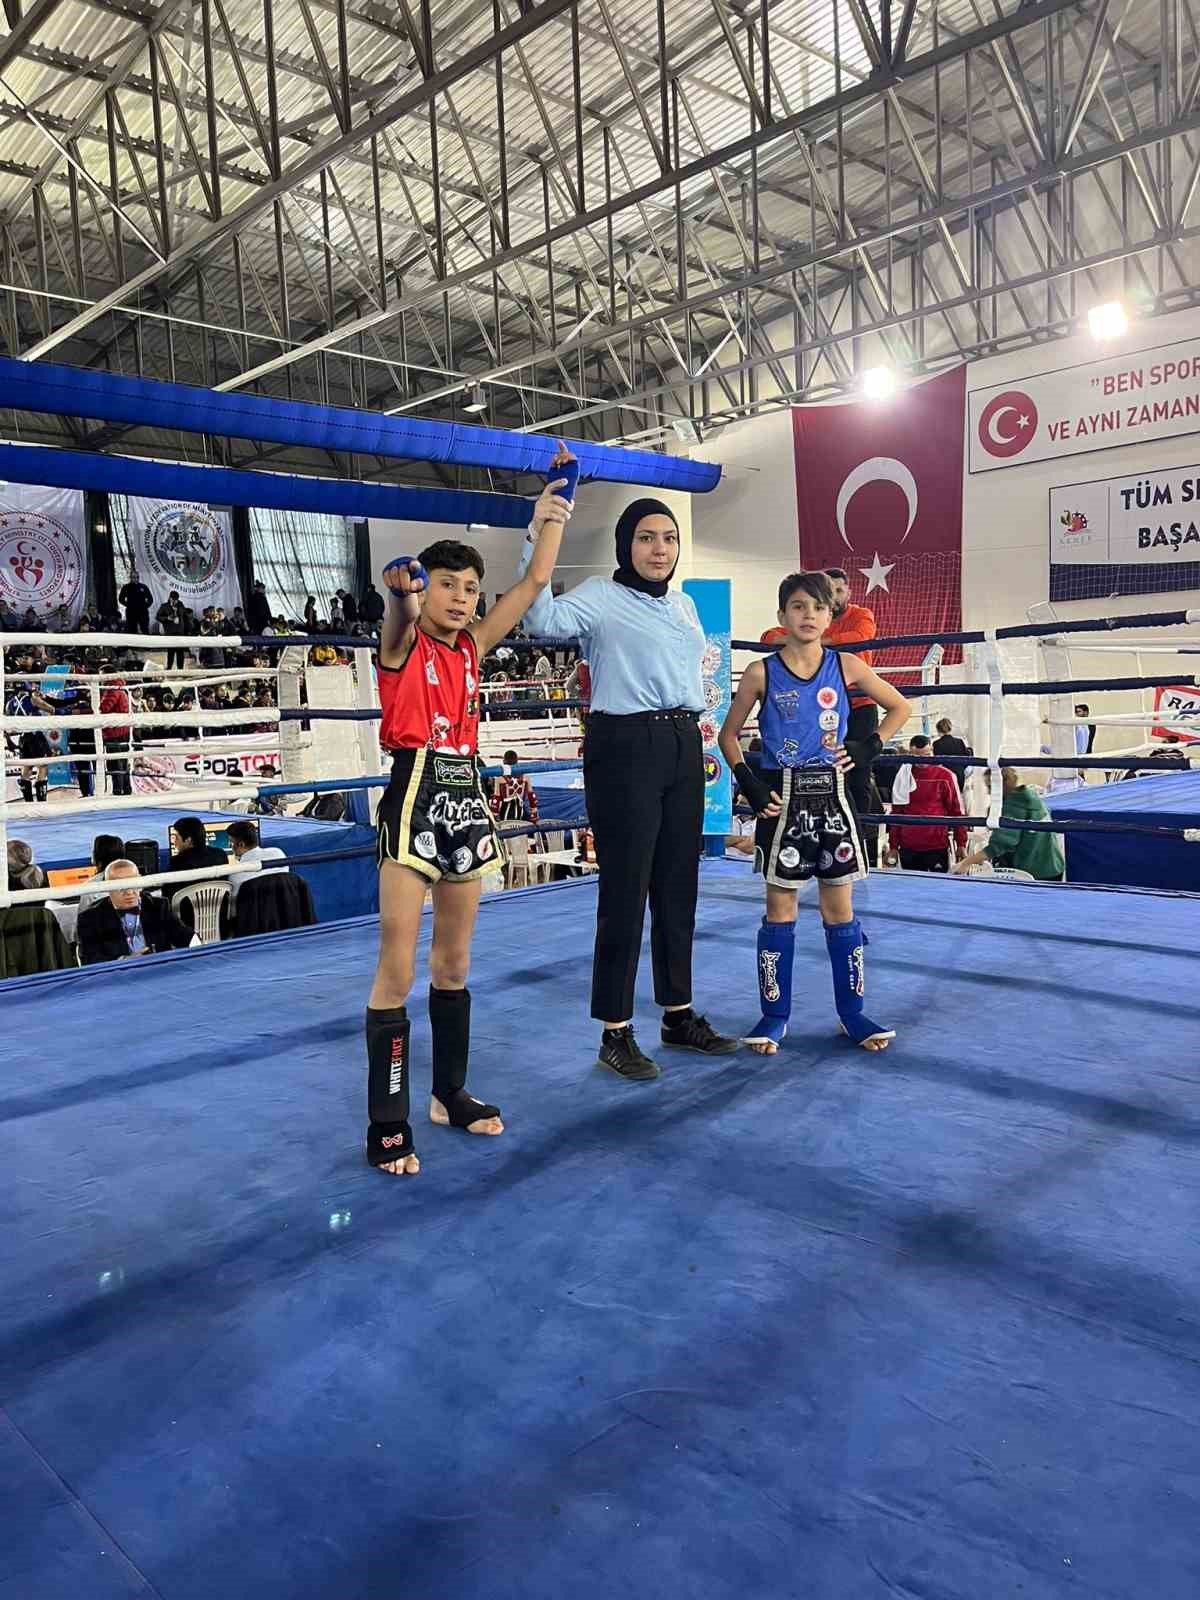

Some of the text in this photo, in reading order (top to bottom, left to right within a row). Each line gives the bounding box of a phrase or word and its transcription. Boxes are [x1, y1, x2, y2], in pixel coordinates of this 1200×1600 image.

[1150, 356, 1200, 386] SPOR
[1048, 394, 1200, 442] VE AYNI ZAMAN
[1120, 480, 1173, 510] TÜM
[1138, 521, 1200, 552] BAŞA
[184, 753, 281, 775] SPORTOT
